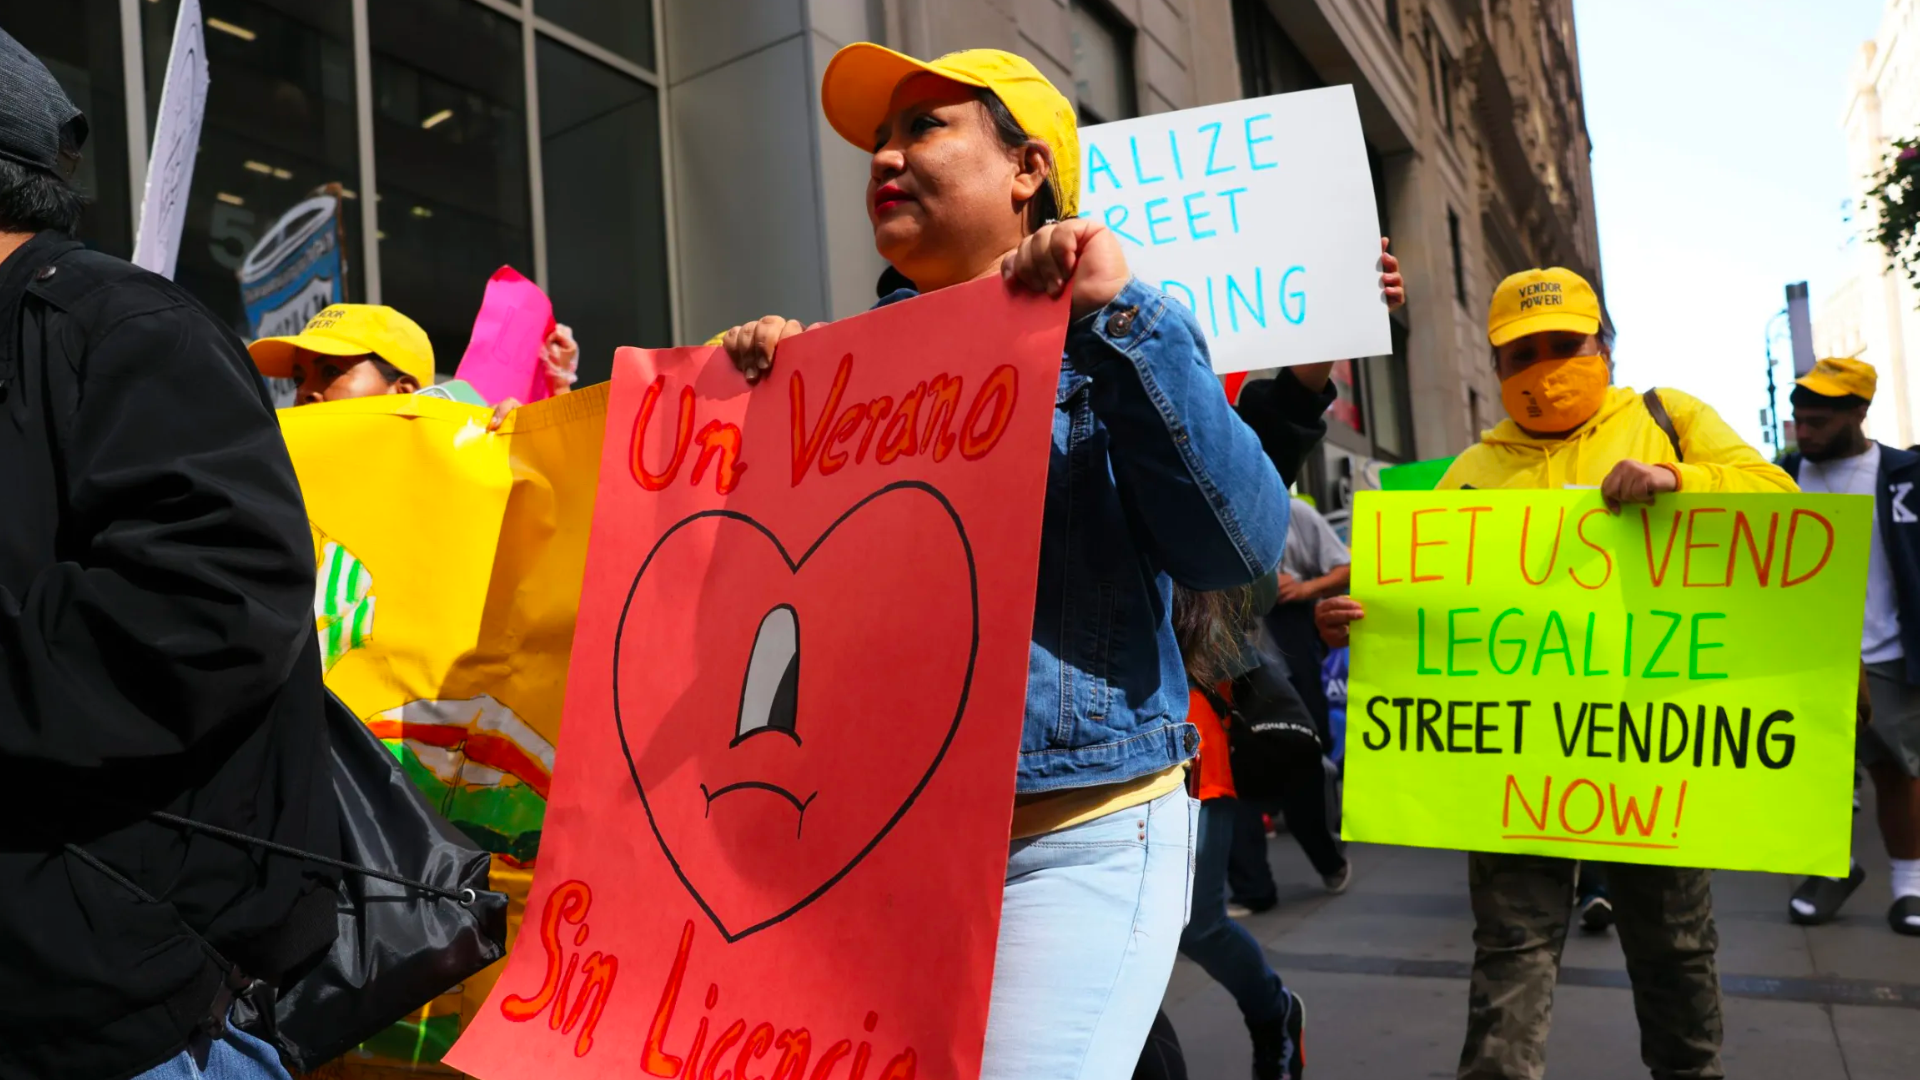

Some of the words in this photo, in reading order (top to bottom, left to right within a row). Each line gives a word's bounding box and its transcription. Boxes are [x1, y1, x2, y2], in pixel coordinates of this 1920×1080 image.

[1086, 112, 1279, 194] ALIZE
[1160, 265, 1307, 338] DING
[1518, 282, 1562, 297] VENDOR
[1520, 294, 1562, 311] POWER!
[628, 374, 748, 495] Un
[788, 352, 1019, 488] Verano
[1889, 482, 1919, 523] K
[1375, 506, 1494, 586] LET
[1519, 506, 1613, 590] US
[1640, 507, 1835, 588] VEND
[1416, 607, 1729, 680] LEGALIZE
[1362, 695, 1531, 756] STREET
[1553, 700, 1797, 770] VENDING
[1501, 773, 1688, 839] NOW!
[500, 880, 619, 1058] Sin
